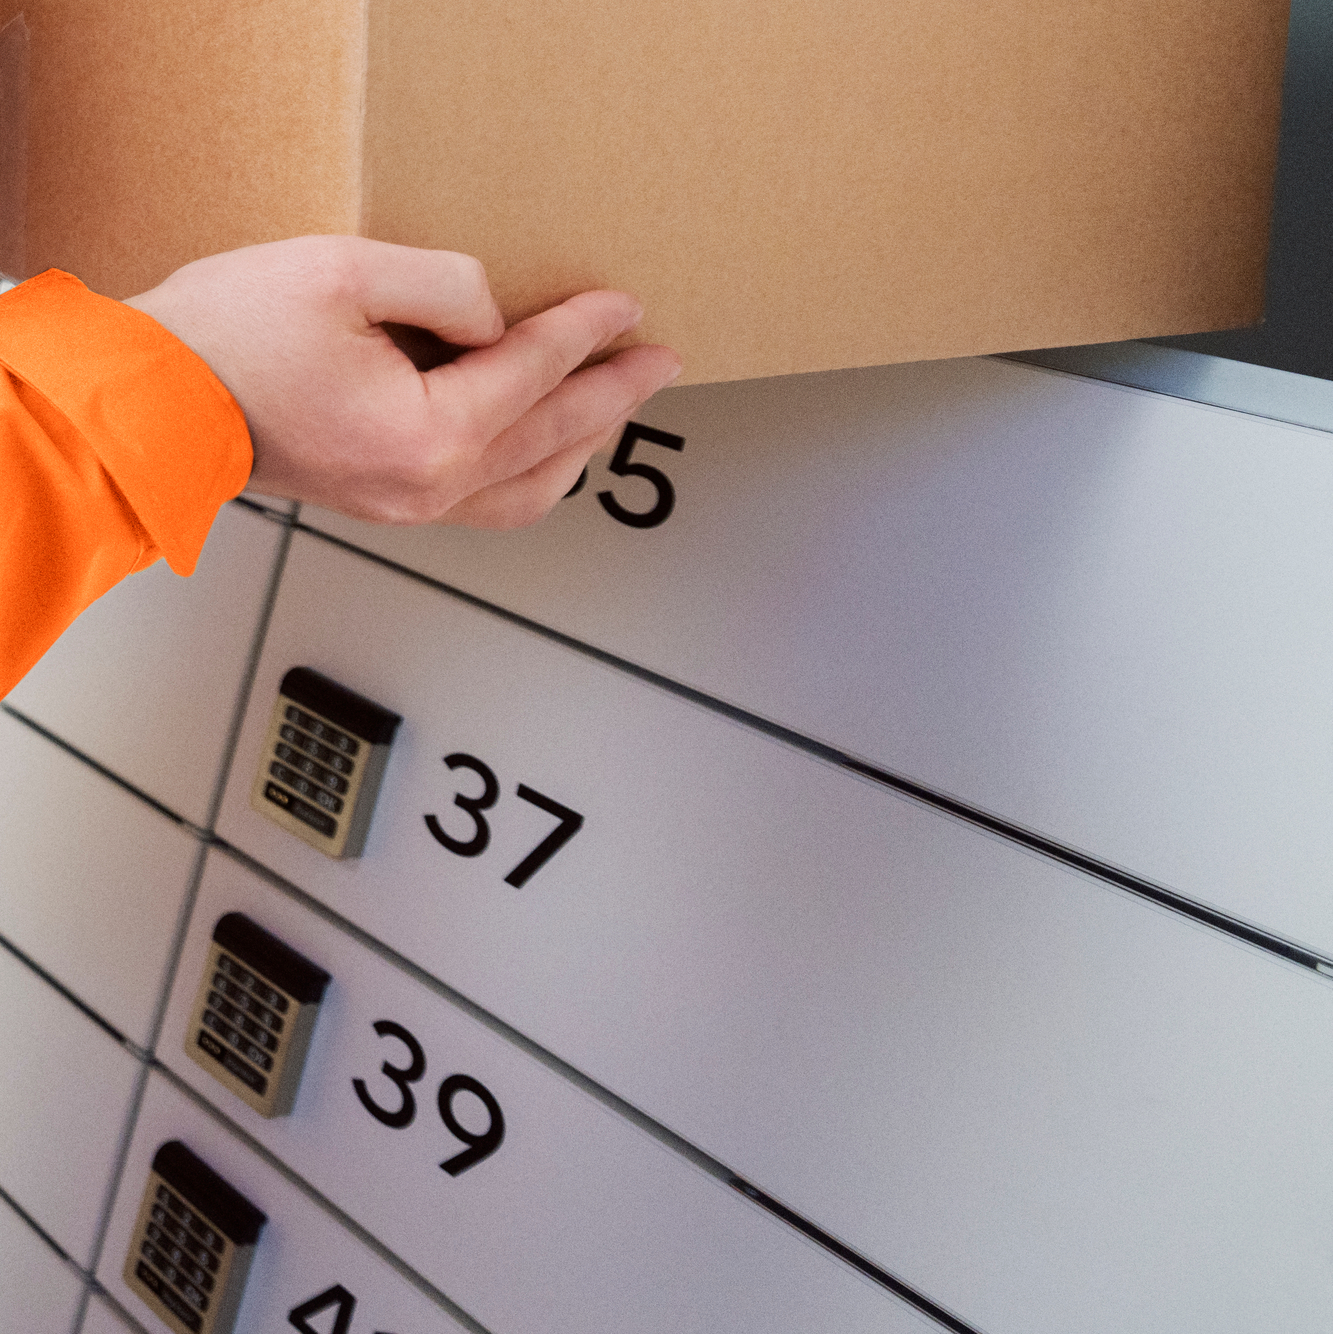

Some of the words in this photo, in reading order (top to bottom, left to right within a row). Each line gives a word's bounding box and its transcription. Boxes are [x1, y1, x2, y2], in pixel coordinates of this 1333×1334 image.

[562, 421, 686, 529] 5
[424, 752, 585, 889] 37
[352, 1019, 507, 1177] 39
